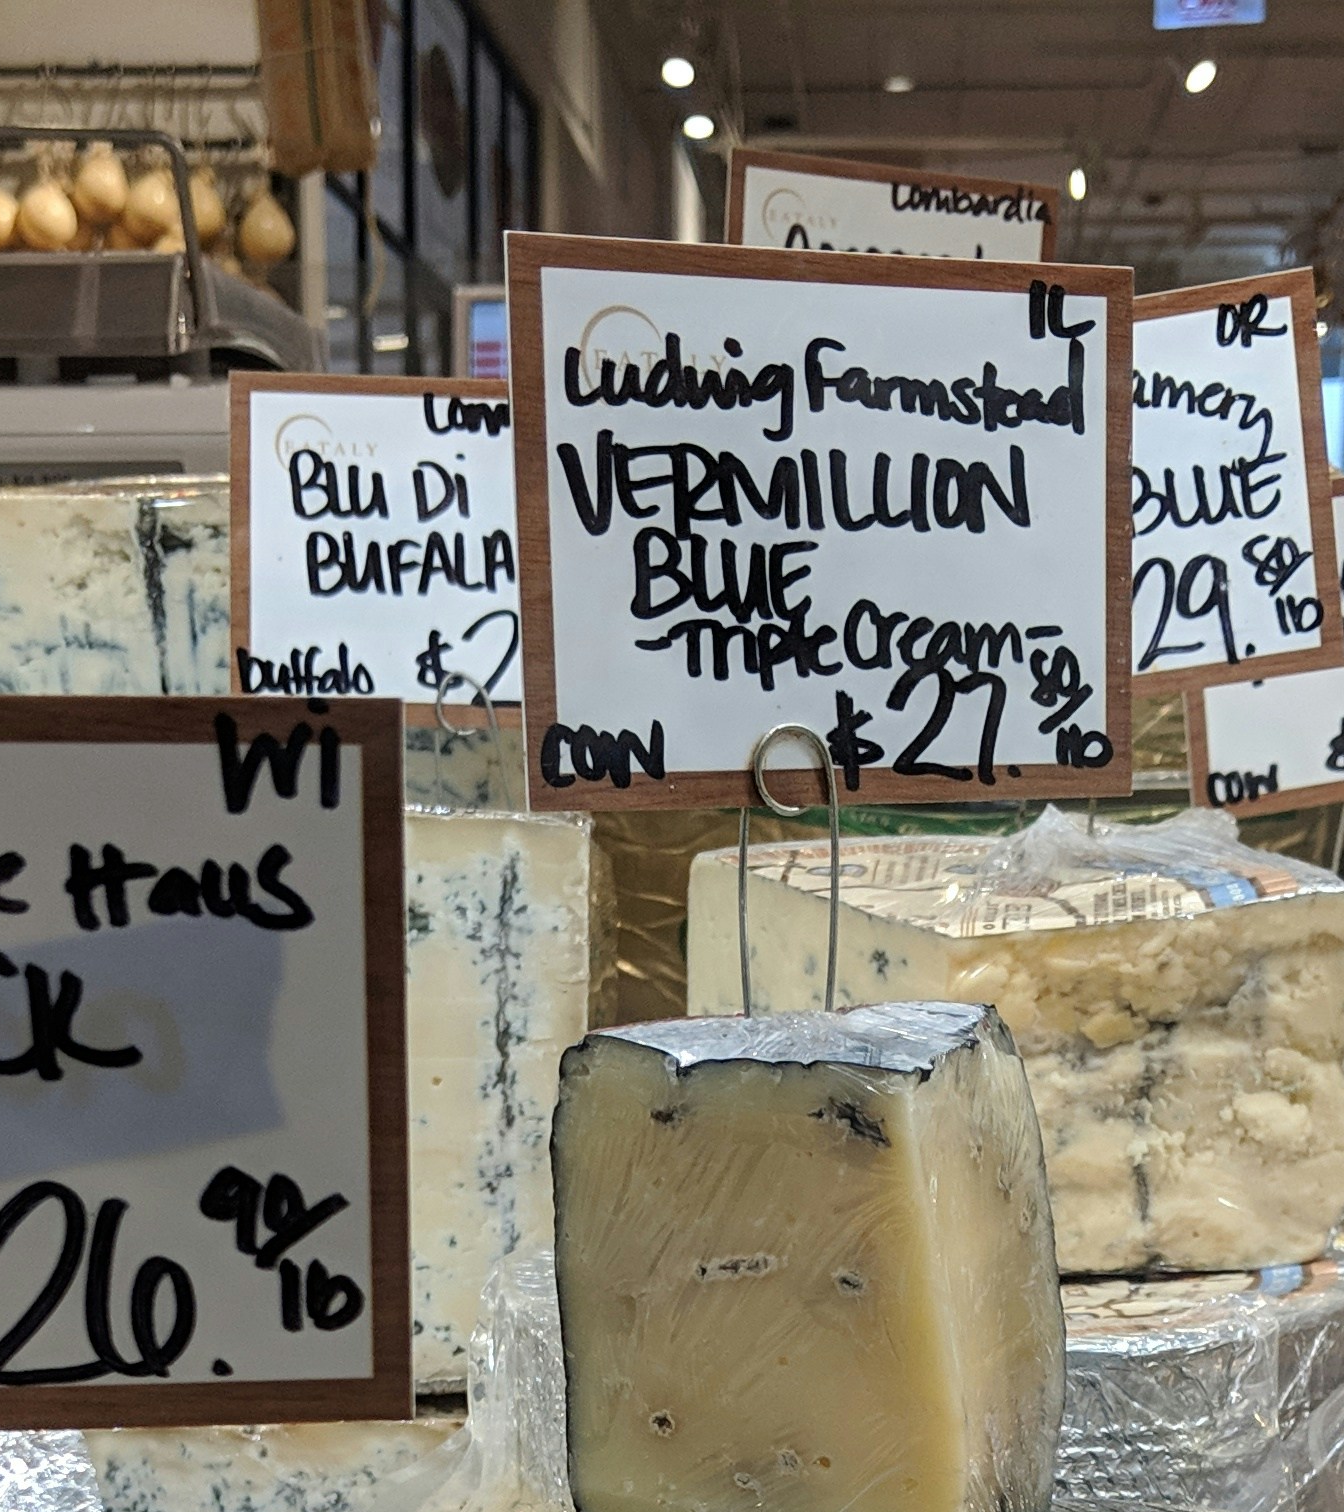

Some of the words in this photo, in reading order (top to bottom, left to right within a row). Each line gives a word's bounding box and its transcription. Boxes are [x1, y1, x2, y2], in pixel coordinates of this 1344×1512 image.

[1029, 280, 1095, 339] IL
[1216, 292, 1288, 348] OR
[289, 448, 389, 521] BLU
[557, 429, 1032, 541] VERMILLION
[306, 529, 516, 597] BUFALA
[629, 526, 820, 626] BLUE
[65, 843, 314, 931] Haus
[277, 1257, 363, 1332] lb
